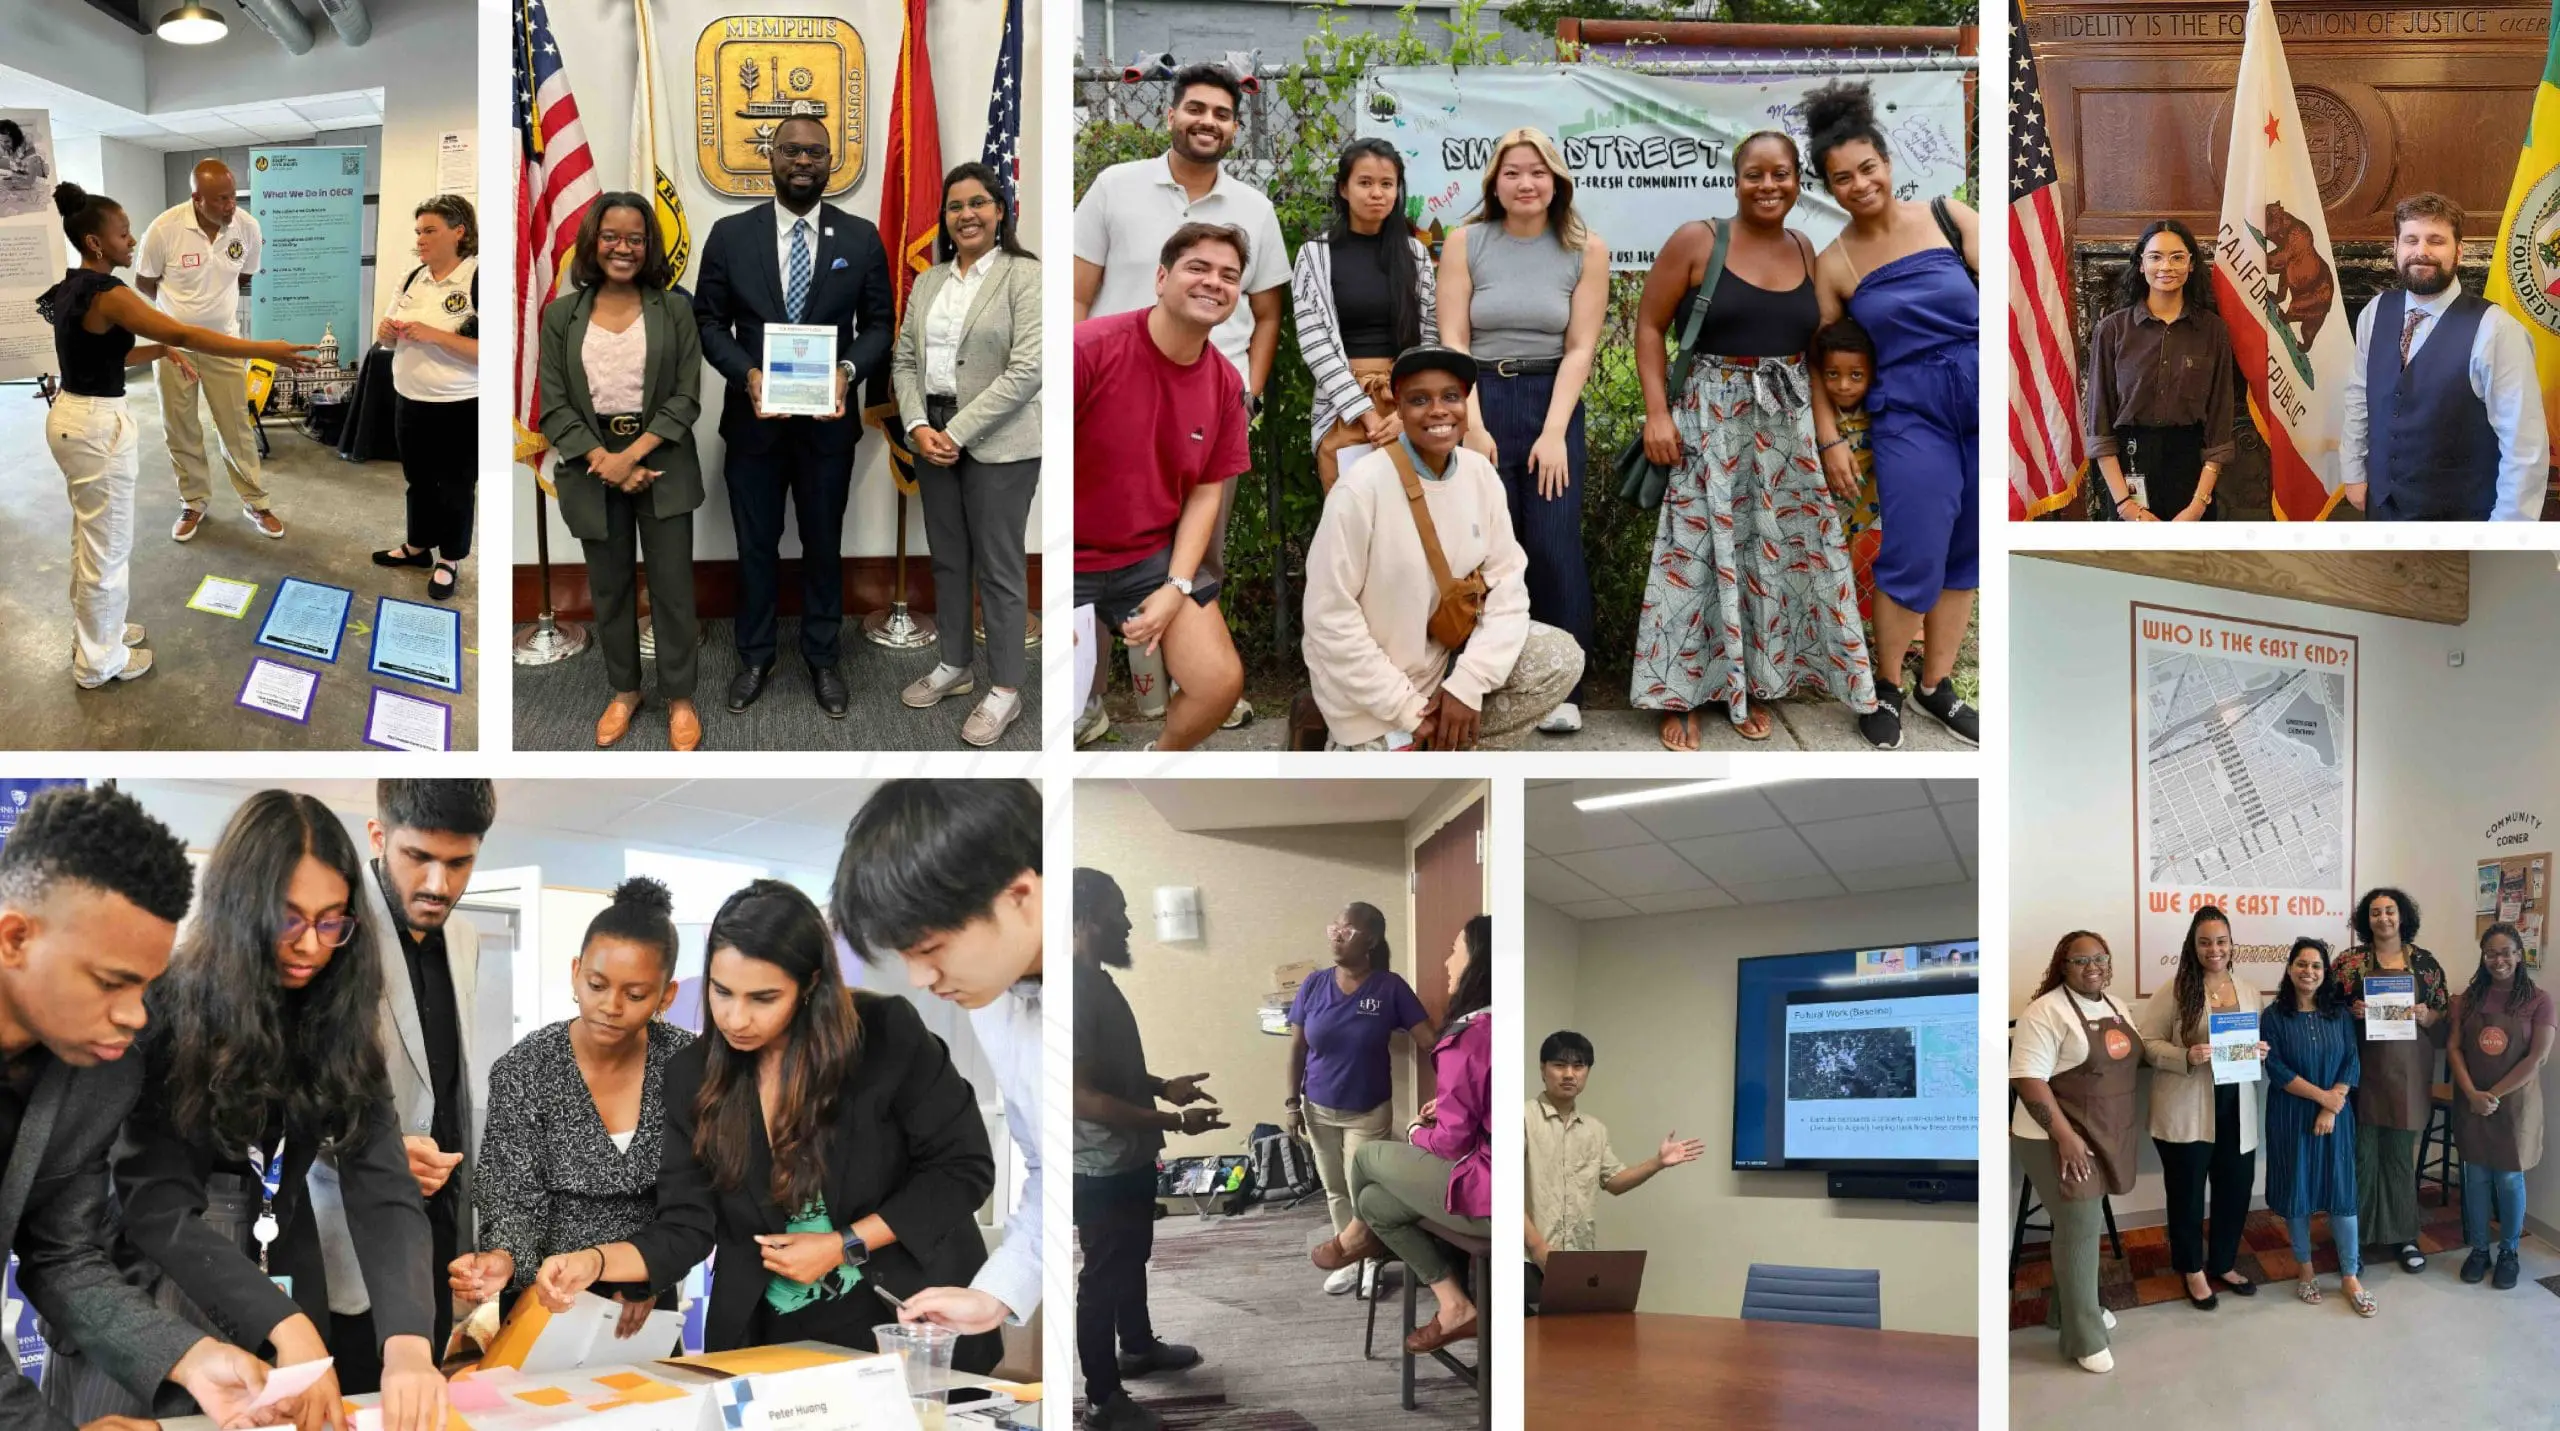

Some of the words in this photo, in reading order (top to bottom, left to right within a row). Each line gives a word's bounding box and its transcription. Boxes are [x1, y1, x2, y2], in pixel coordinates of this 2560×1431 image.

[726, 19, 837, 38] MEMPHIS
[2146, 15, 2161, 36] IS
[2169, 15, 2208, 36] THE
[2367, 13, 2396, 34] OF
[700, 75, 715, 146] SHELBY
[848, 69, 862, 145] COUNTY
[1564, 136, 1724, 170] STREET
[1627, 175, 1698, 188] COMMUNITY
[1702, 175, 1734, 188] GARD
[262, 190, 287, 199] What
[289, 189, 304, 198] We
[305, 189, 317, 197] Do
[1616, 250, 1633, 263] US!
[2512, 233, 2546, 316] FOUNDED
[2142, 620, 2194, 644] WHO
[2199, 628, 2213, 648] IS
[2220, 631, 2253, 654] THE
[2259, 638, 2299, 659] EAST
[2304, 644, 2349, 667] END?
[2486, 811, 2542, 839] COMMUNITY
[2497, 832, 2529, 847] CORNER
[2149, 891, 2182, 913] WE
[2236, 894, 2280, 916] EAST
[2287, 895, 2344, 917] END...
[769, 1408, 794, 1420] Peter
[796, 1402, 828, 1417] Huang
